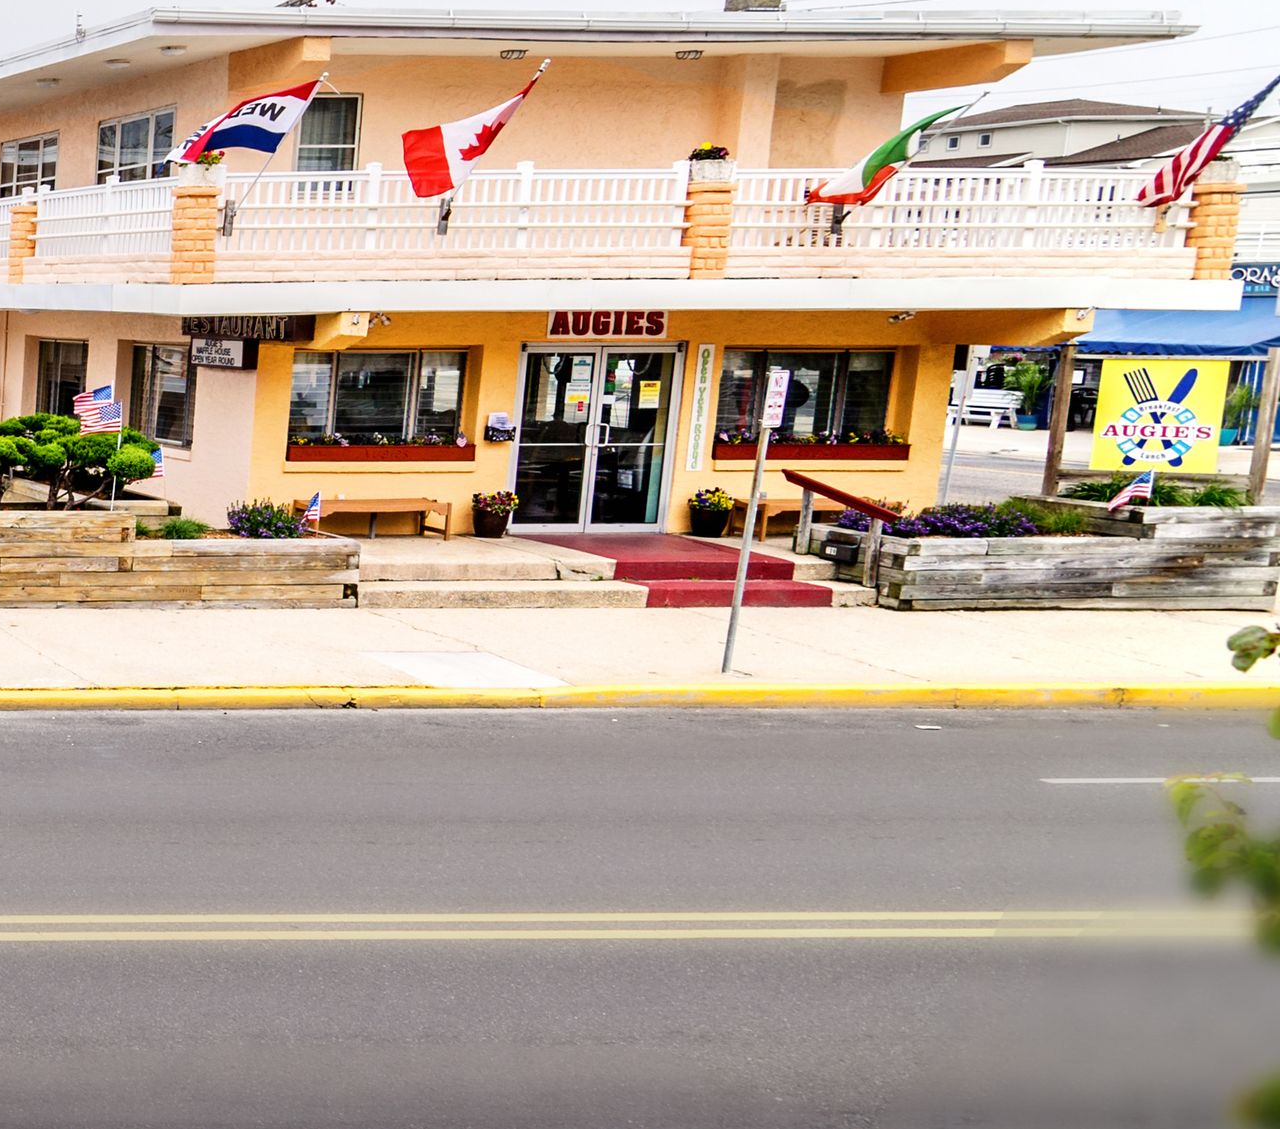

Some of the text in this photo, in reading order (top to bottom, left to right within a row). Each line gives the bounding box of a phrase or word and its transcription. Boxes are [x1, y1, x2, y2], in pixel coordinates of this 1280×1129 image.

[550, 311, 665, 335] AUGIES
[215, 348, 231, 356] HOUSE
[191, 355, 235, 366] OPEN YEAR ROUND
[1138, 404, 1180, 413] Breakfast
[1103, 424, 1211, 439] AUGIE'S
[1140, 452, 1166, 460] Lunch
